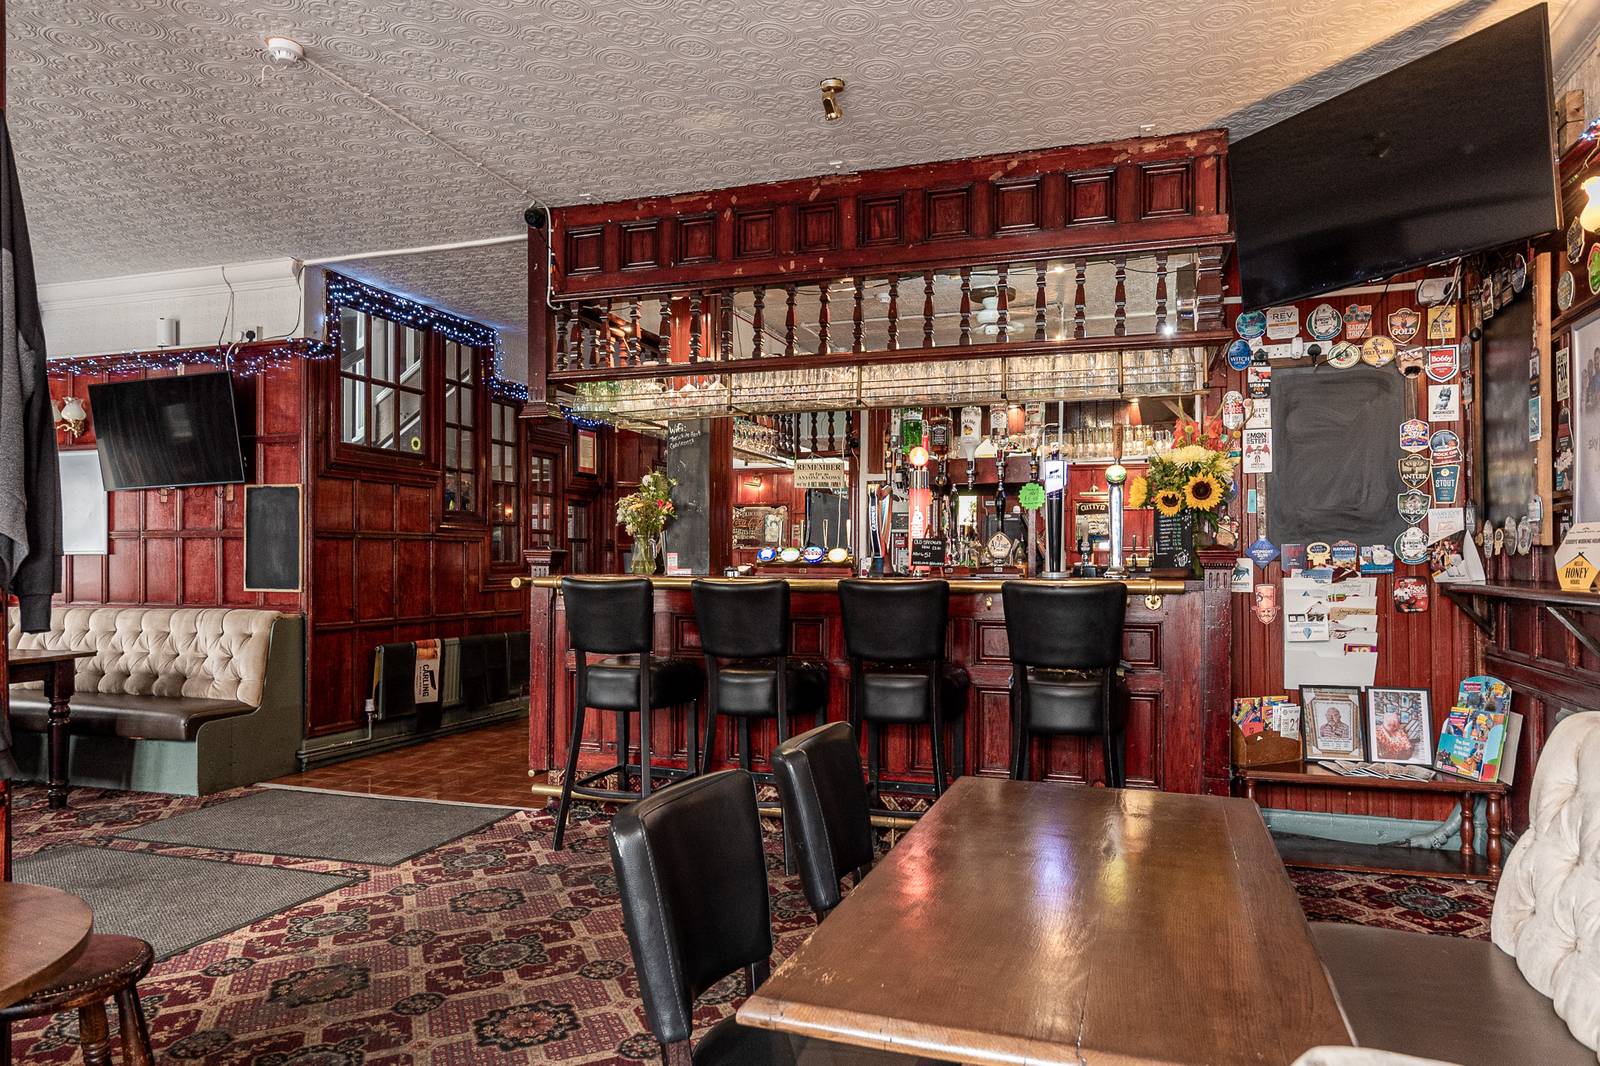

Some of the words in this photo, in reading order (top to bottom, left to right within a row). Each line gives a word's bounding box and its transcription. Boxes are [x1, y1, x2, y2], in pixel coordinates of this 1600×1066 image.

[1272, 312, 1293, 320] REV
[1392, 328, 1416, 336] GOLD
[1431, 354, 1453, 363] Bobby
[1557, 362, 1569, 381] FOX
[1435, 480, 1455, 488] STOUT
[1565, 568, 1589, 579] HONEY
[422, 664, 430, 697] CARLING
